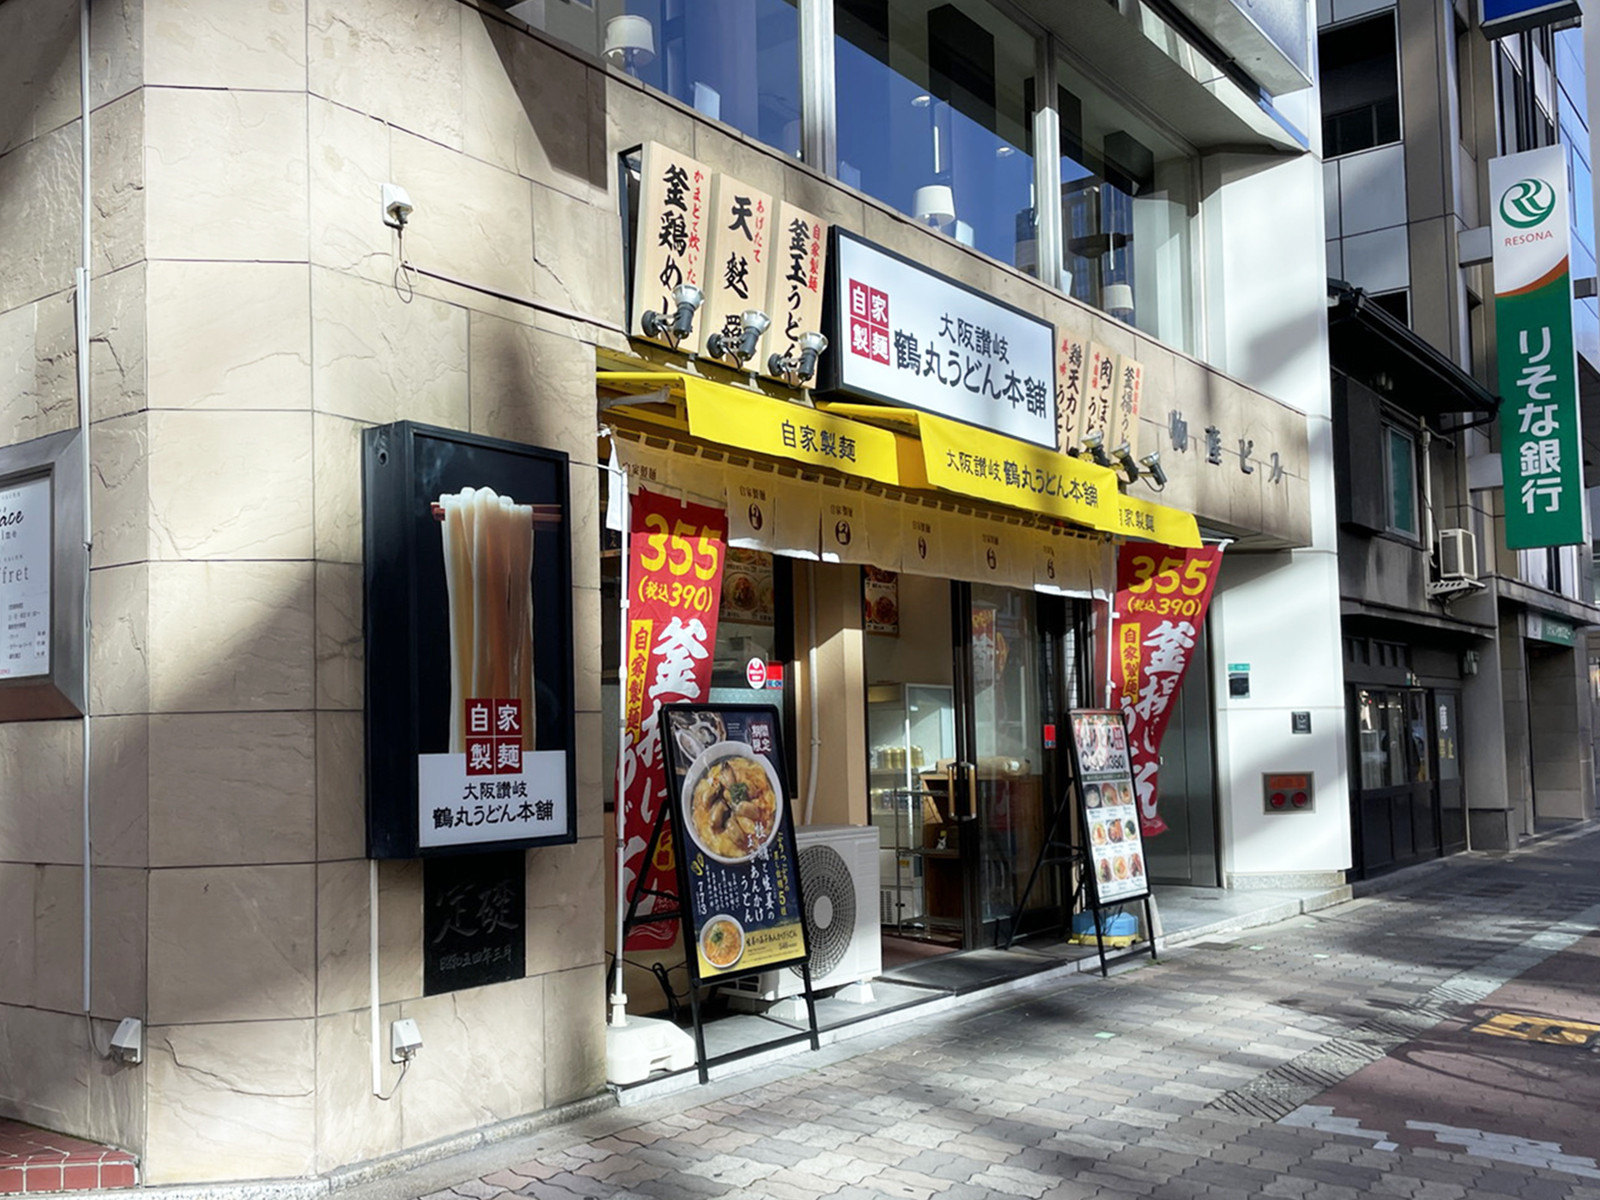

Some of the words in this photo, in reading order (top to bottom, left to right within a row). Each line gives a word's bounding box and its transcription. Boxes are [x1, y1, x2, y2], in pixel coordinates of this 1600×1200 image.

[754, 200, 766, 263] あげたて
[1504, 230, 1554, 247] RESONA
[852, 286, 888, 324] 自家
[852, 323, 890, 361] 製麺
[939, 312, 1010, 364] 大阪讃岐
[1086, 396, 1098, 435] うど
[1516, 326, 1562, 514] りそな銀行
[781, 419, 856, 463] 自家製麺
[946, 448, 1002, 482] 大阪讃岐
[640, 513, 723, 581] 355
[0, 565, 29, 585] fret
[638, 575, 713, 613] (税込390)
[1128, 556, 1213, 596] 355
[1127, 596, 1202, 617] (税込390)
[1123, 627, 1138, 695] 自家製麺
[470, 703, 520, 732] 自家
[469, 742, 521, 770] 製麺
[463, 781, 528, 800] 大阪讃岐
[697, 881, 708, 915] 773
